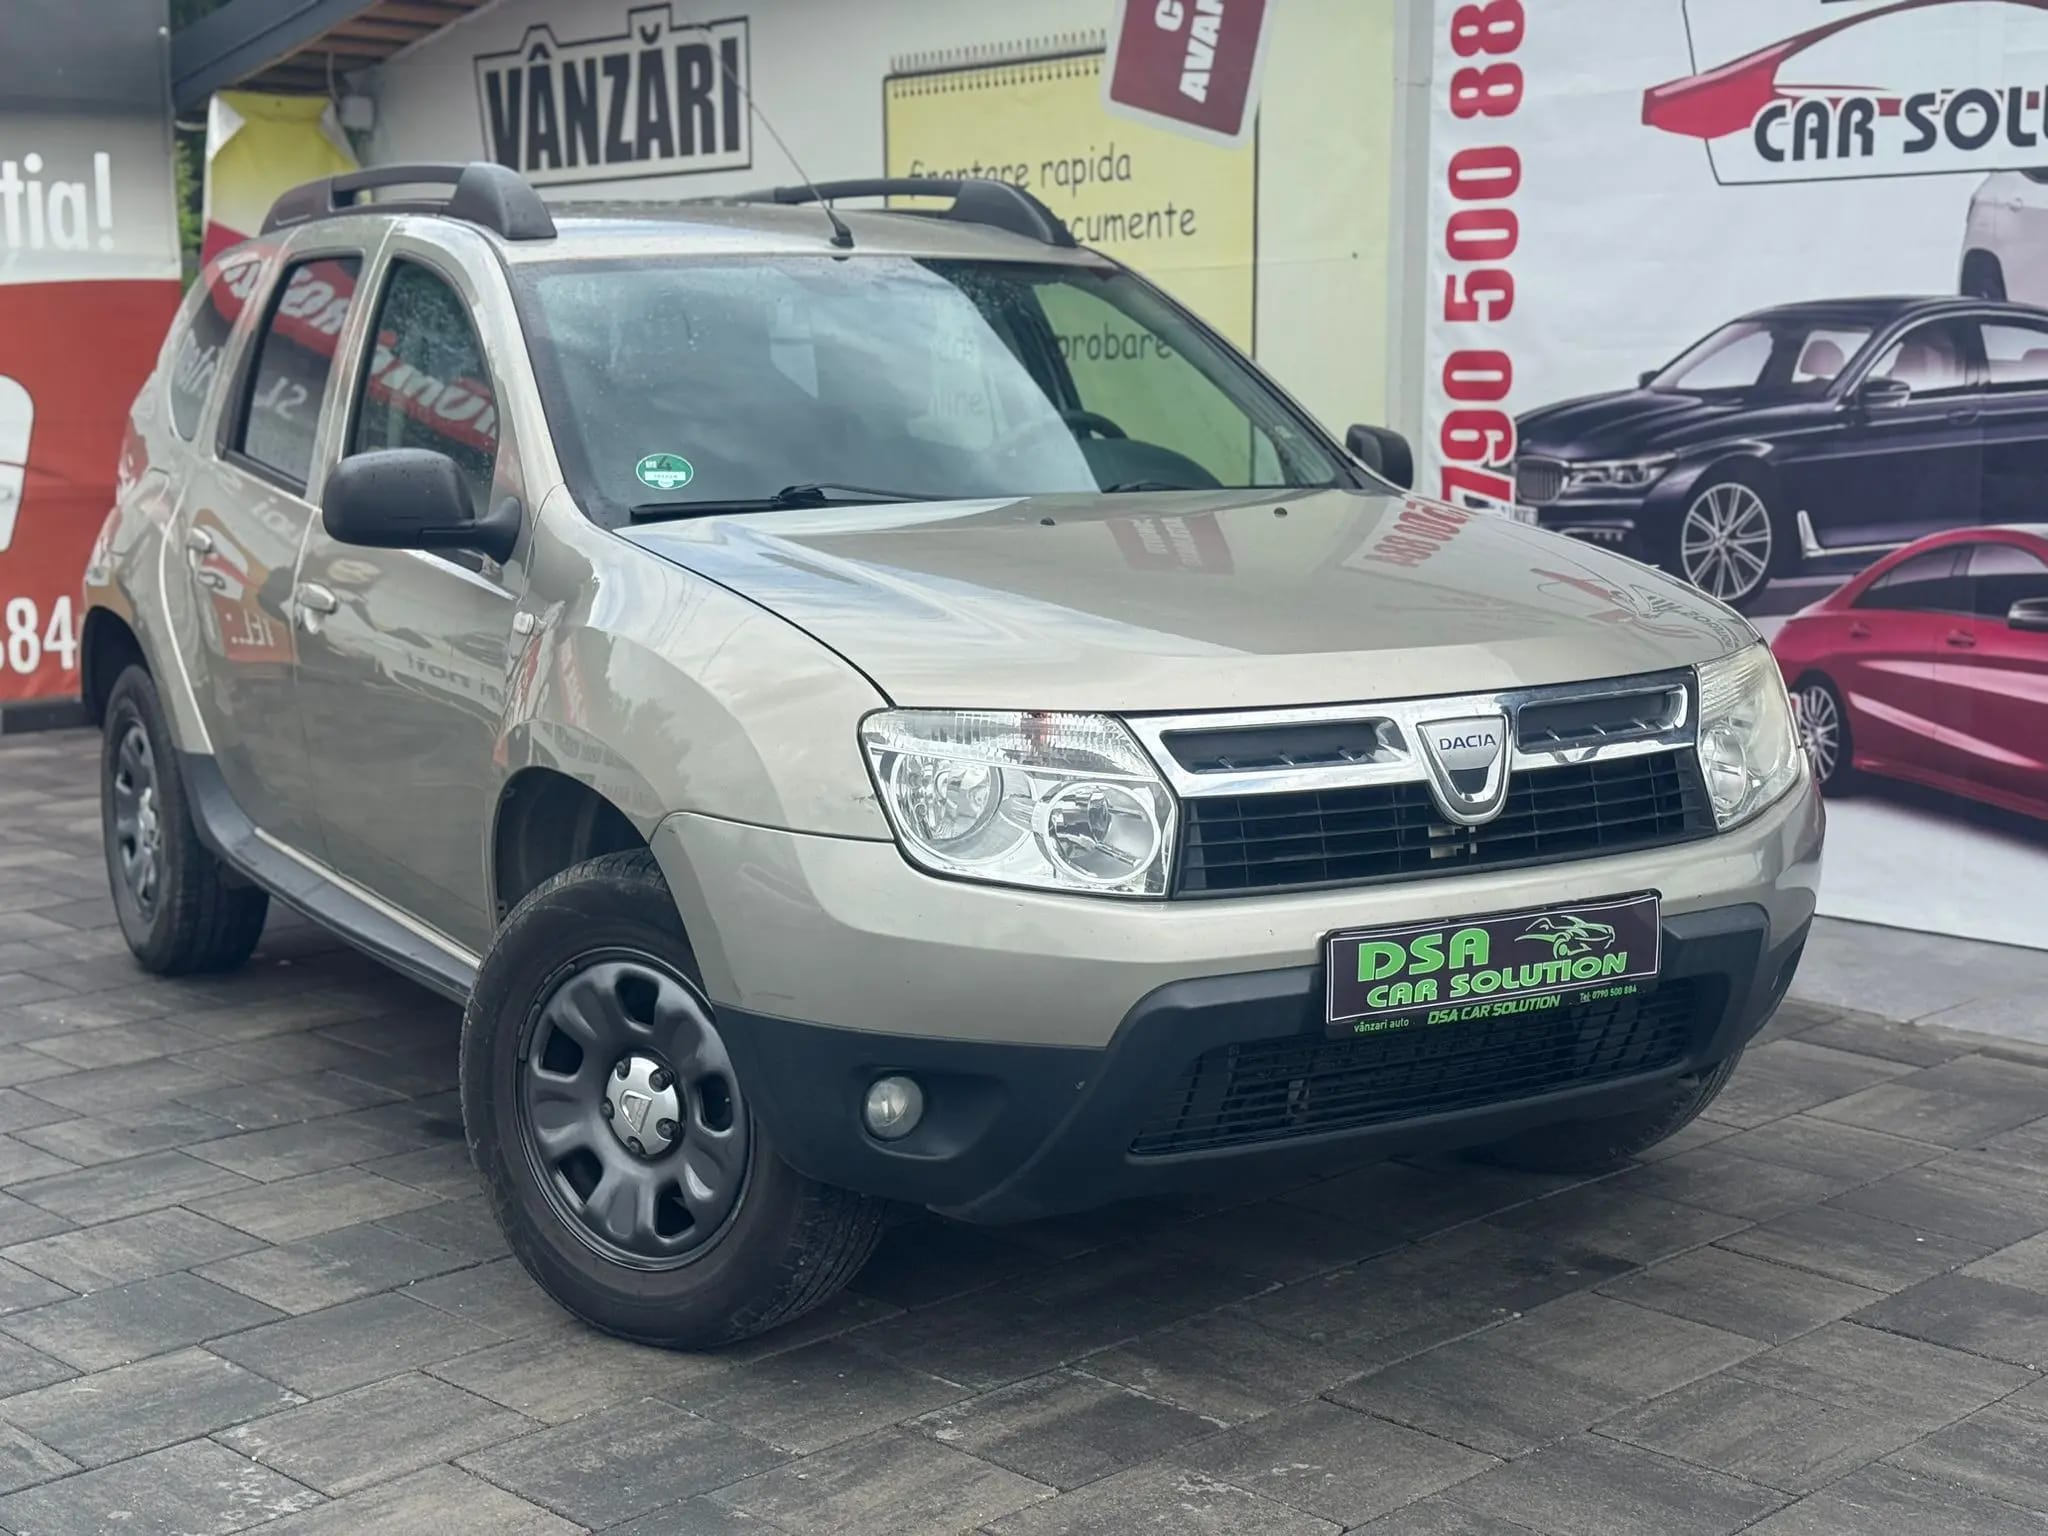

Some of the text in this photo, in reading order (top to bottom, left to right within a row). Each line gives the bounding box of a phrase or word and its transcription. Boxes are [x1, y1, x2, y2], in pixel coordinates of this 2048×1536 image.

[485, 23, 740, 172] VÂNZĂRI
[1754, 87, 2048, 162] CAR SOL
[1040, 143, 1131, 197] rapida
[1444, 146, 1521, 323] 500
[0, 595, 78, 674] 84
[1439, 734, 1496, 750] DACIA
[1358, 928, 1490, 982] DSA
[1366, 951, 1628, 1008] CAR SOLUTION
[1427, 994, 1561, 1025] DSA CAR SOLUTION
